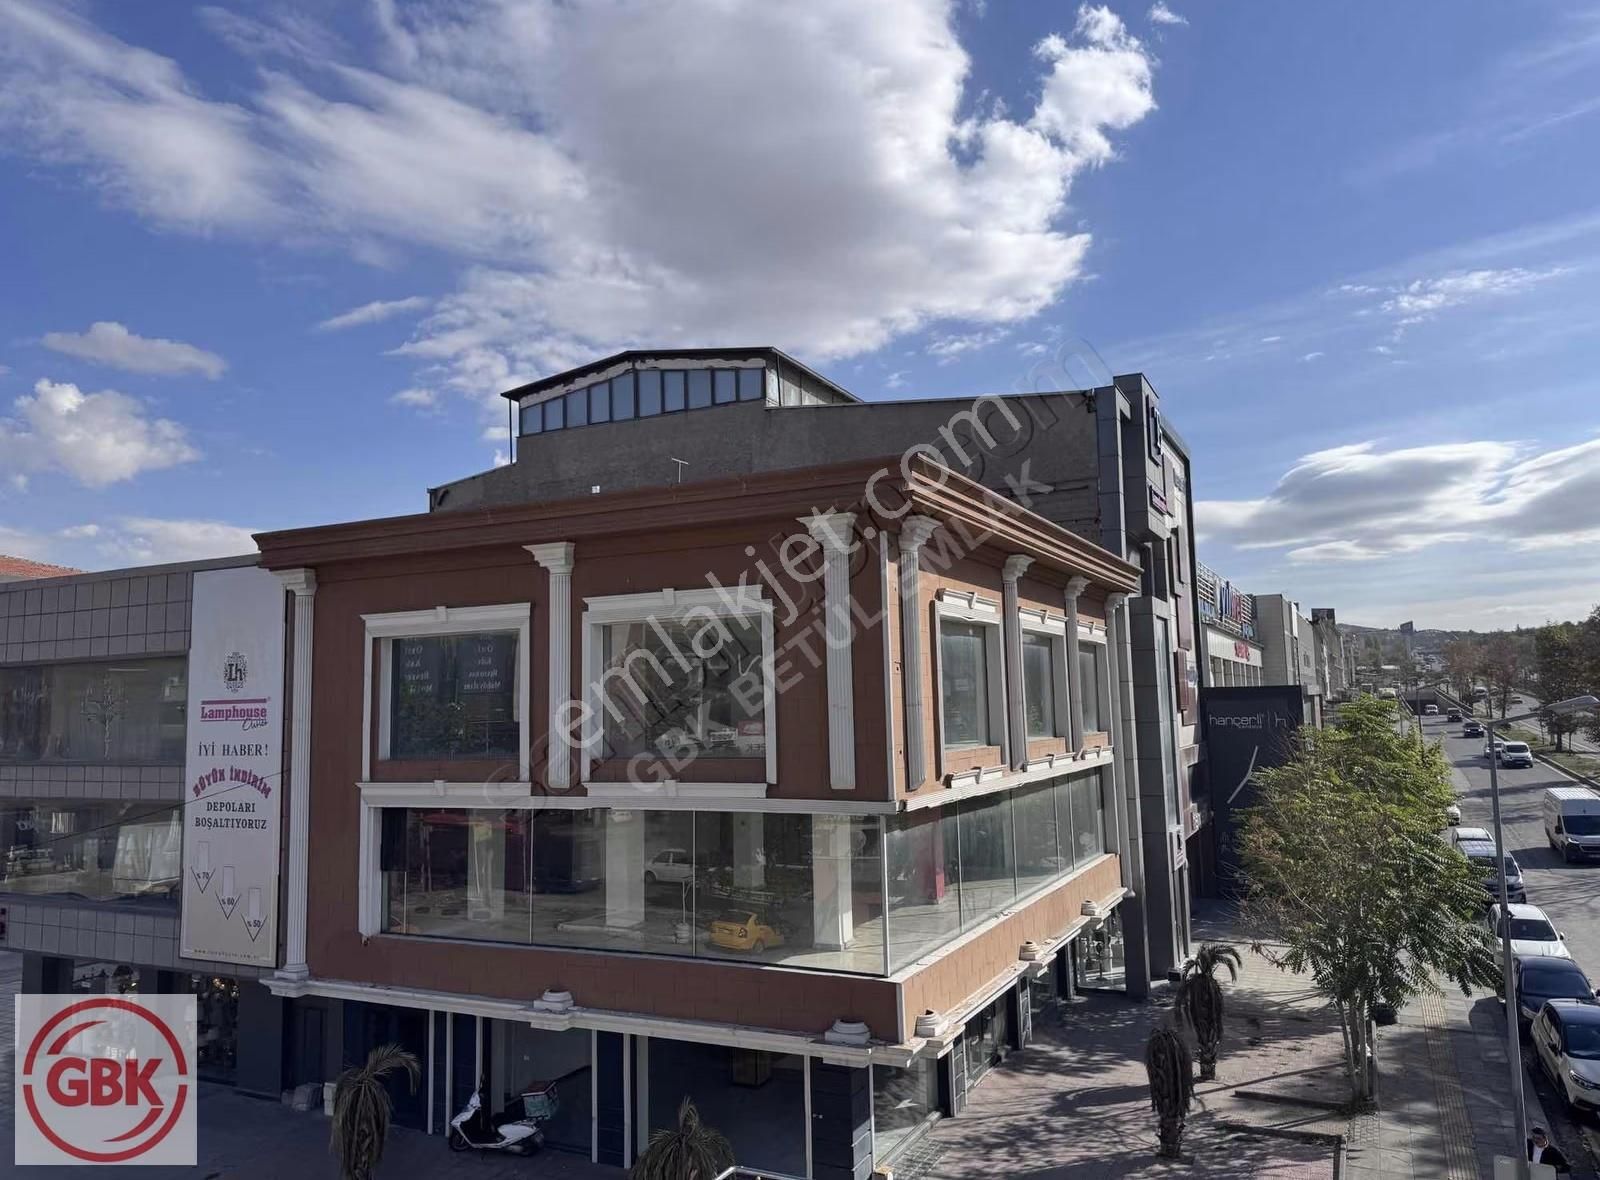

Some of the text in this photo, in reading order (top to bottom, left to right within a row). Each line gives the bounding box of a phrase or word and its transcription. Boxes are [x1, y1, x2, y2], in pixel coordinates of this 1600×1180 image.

[200, 705, 267, 721] Lamphouse
[198, 740, 269, 757] İYİ HABER!
[206, 801, 256, 813] DEPOLARI
[195, 817, 266, 830] BOŞALTIYORUZ
